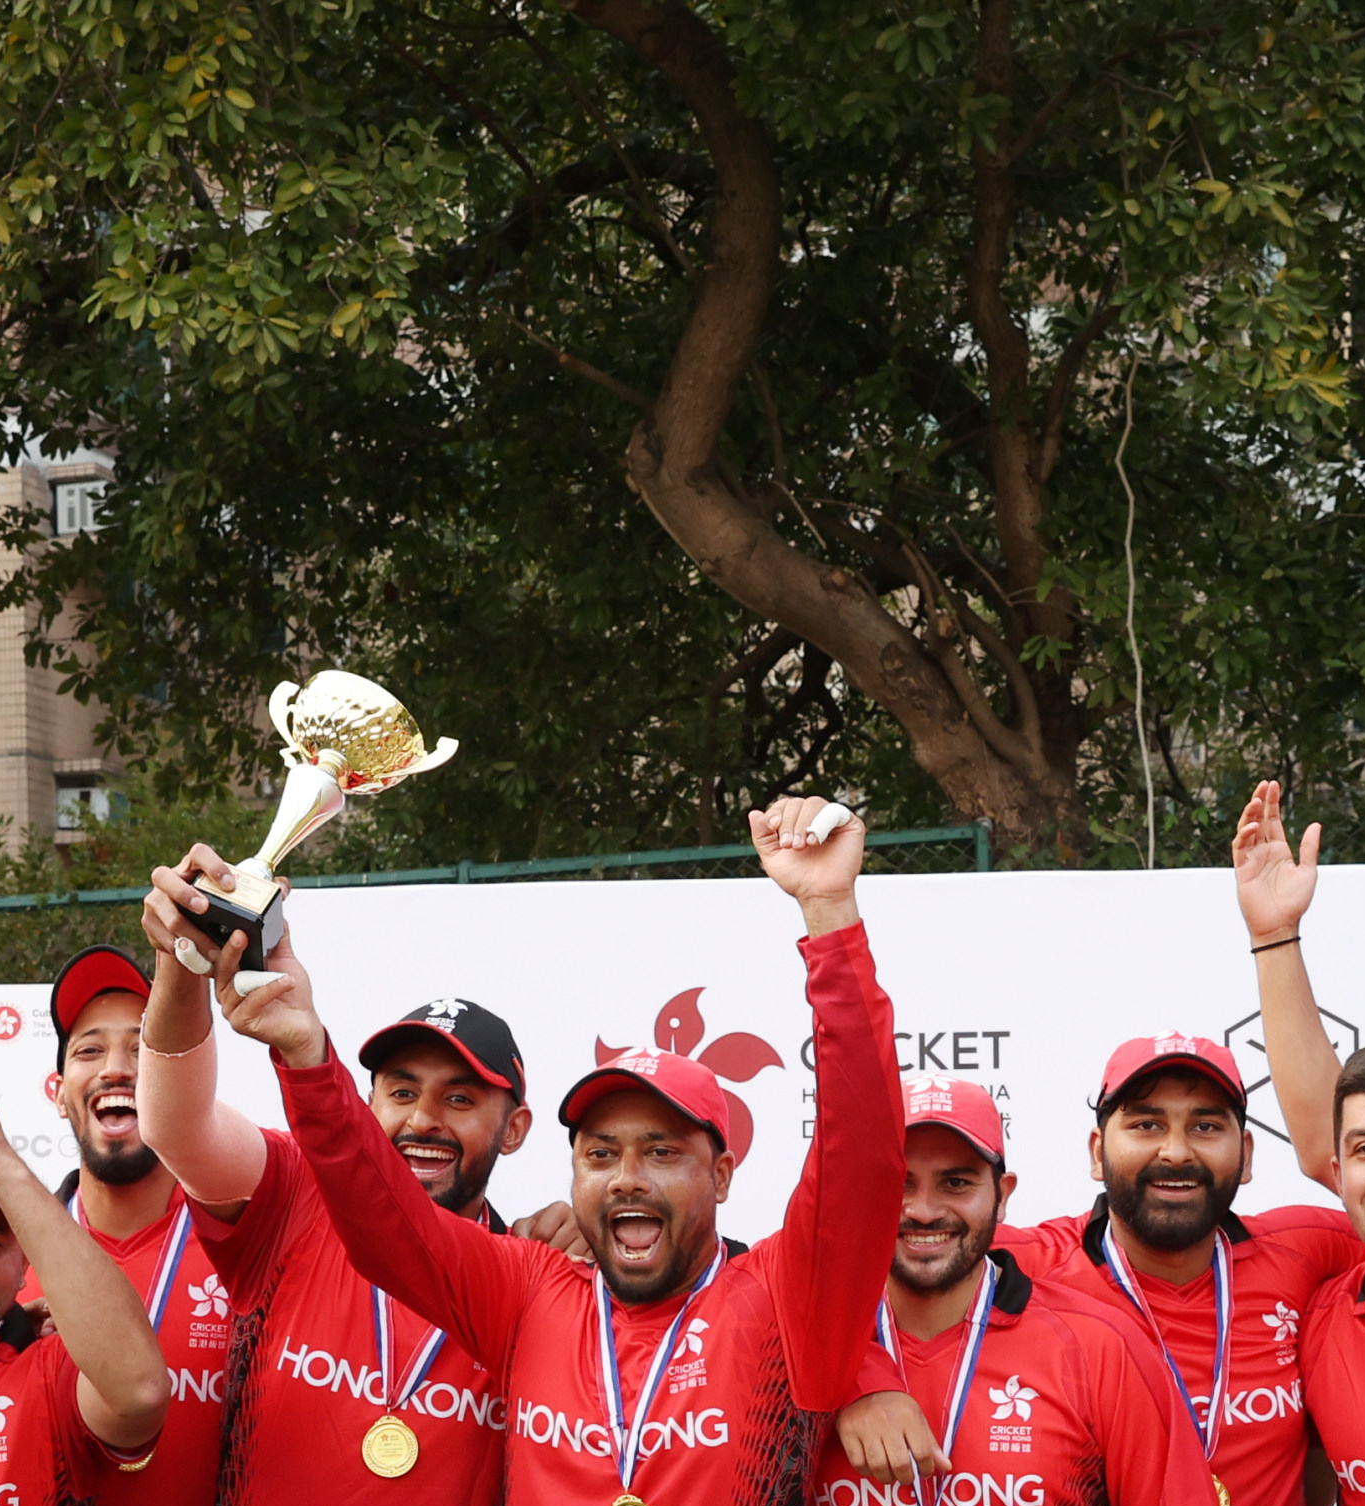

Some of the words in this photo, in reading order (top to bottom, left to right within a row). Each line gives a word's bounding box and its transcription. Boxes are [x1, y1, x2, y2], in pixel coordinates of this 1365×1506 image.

[11, 1134, 53, 1157] PC
[190, 1322, 228, 1333] CRICKET
[668, 1358, 705, 1376] CRICKET
[277, 1335, 387, 1406] HONG
[401, 1379, 507, 1431] KONG
[516, 1397, 611, 1457] HONG
[990, 1425, 1032, 1435] CRICKET
